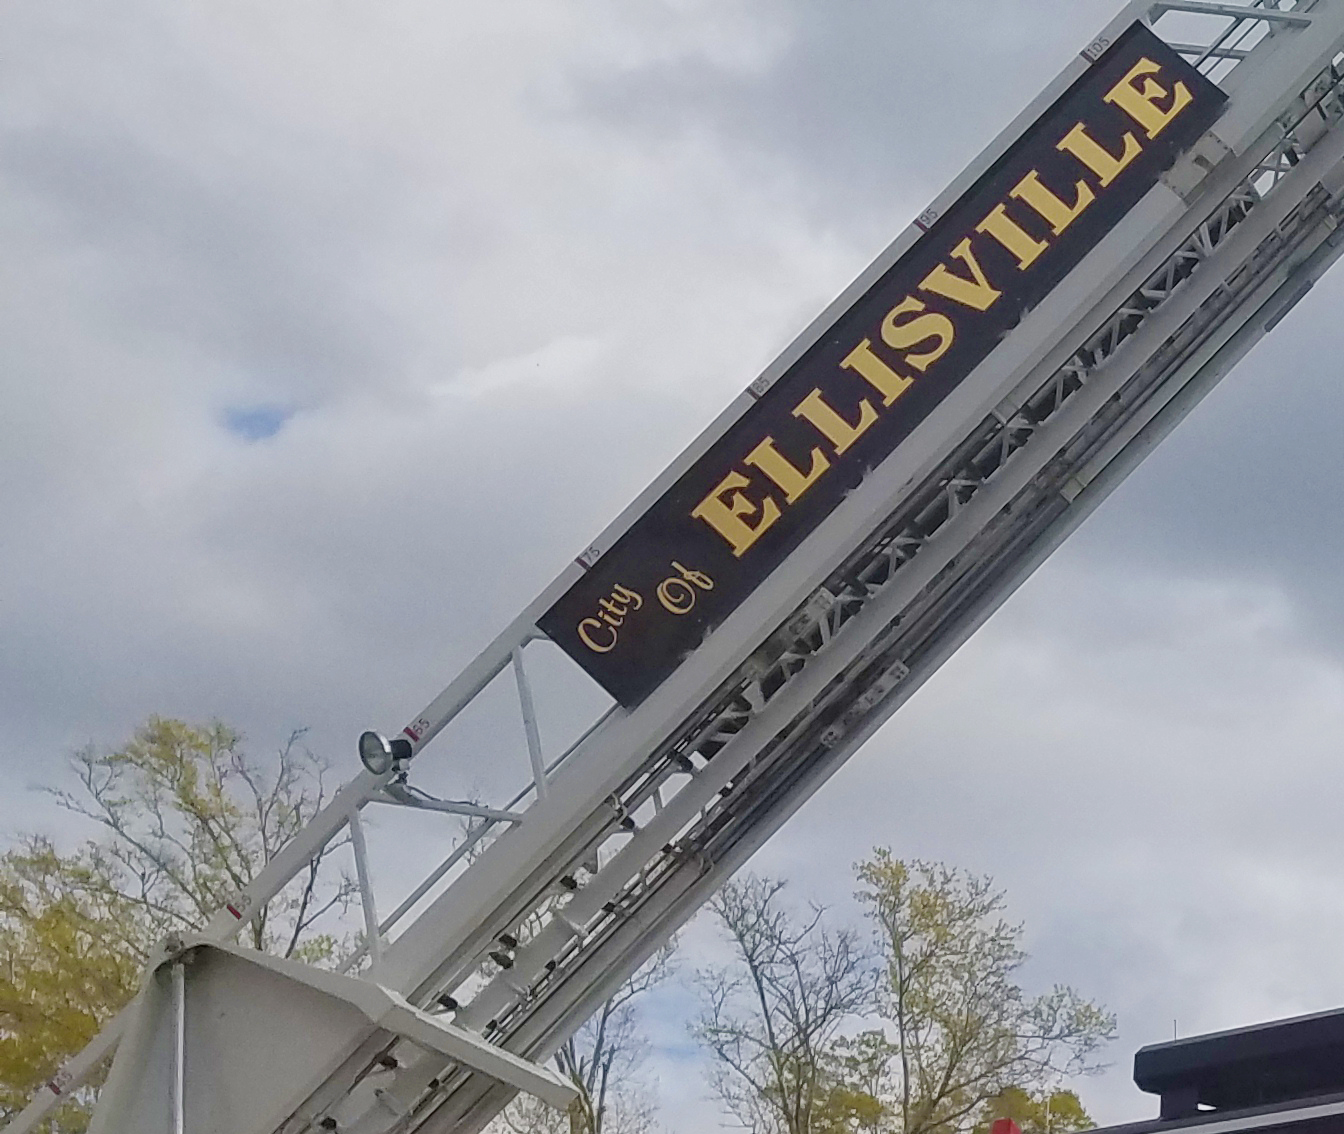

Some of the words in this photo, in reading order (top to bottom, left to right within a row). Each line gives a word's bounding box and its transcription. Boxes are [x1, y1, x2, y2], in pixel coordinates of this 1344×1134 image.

[1087, 37, 1110, 57] 105
[920, 208, 938, 225] 95
[577, 583, 643, 653] City
[656, 560, 714, 615] Of
[690, 56, 1194, 558] ELLISVILLE
